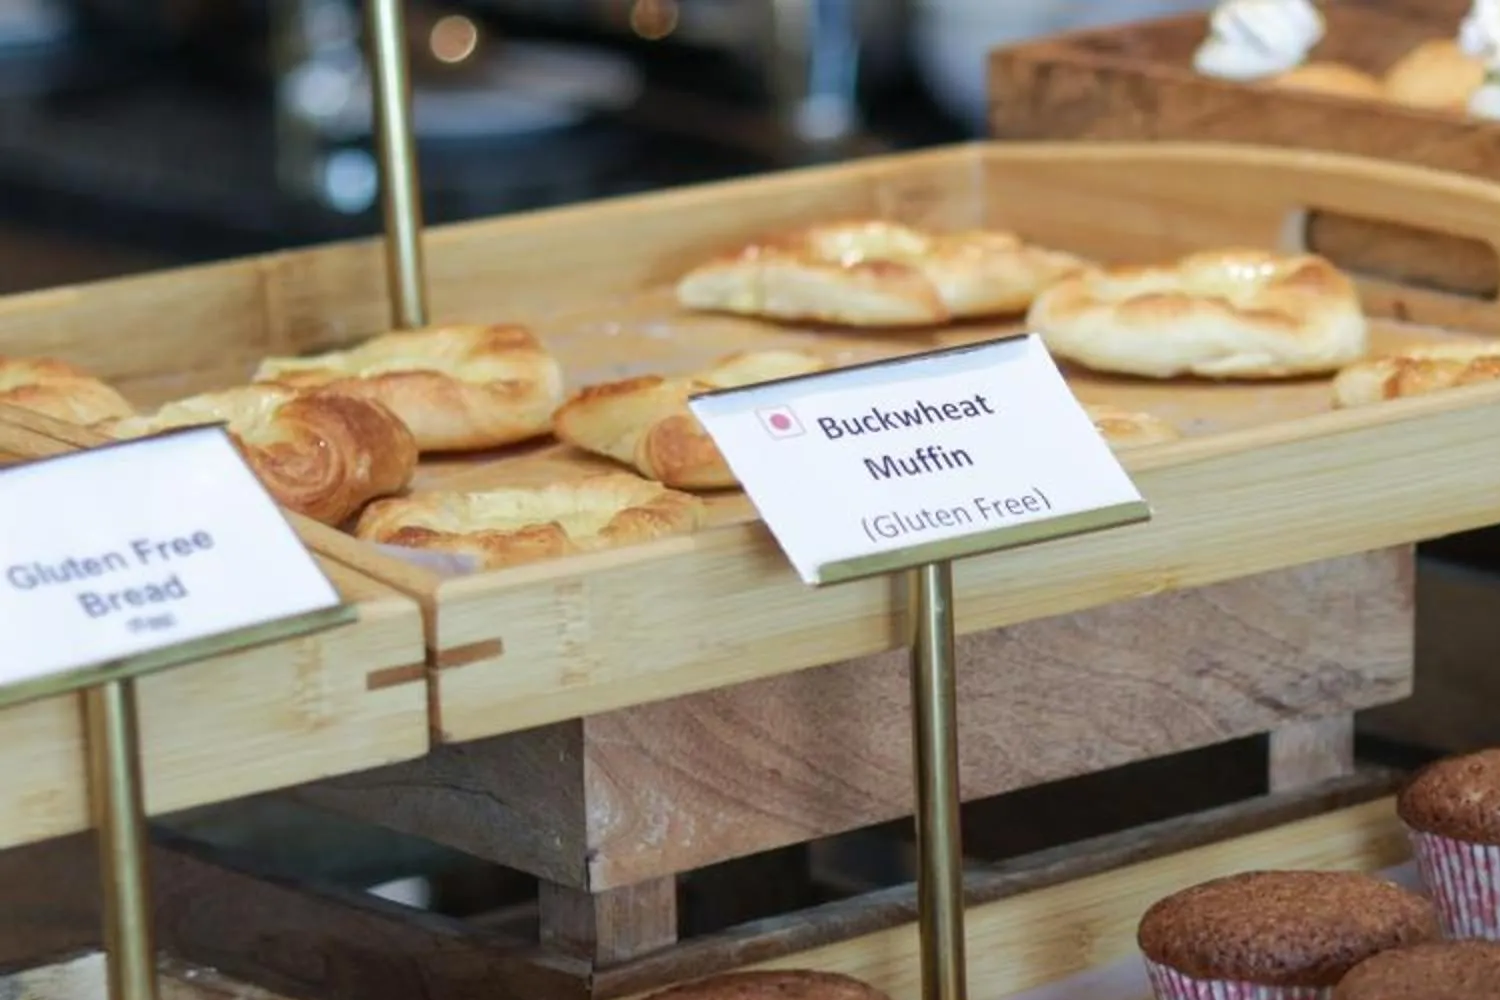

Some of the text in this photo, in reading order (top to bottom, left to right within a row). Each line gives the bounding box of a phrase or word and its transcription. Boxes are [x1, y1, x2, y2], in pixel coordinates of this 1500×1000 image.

[817, 392, 994, 440] Buckwheat
[864, 445, 973, 480] Muffin
[861, 487, 1051, 542] (Gluten Free)
[7, 530, 214, 590] Gluten Free
[78, 575, 187, 618] Bread
